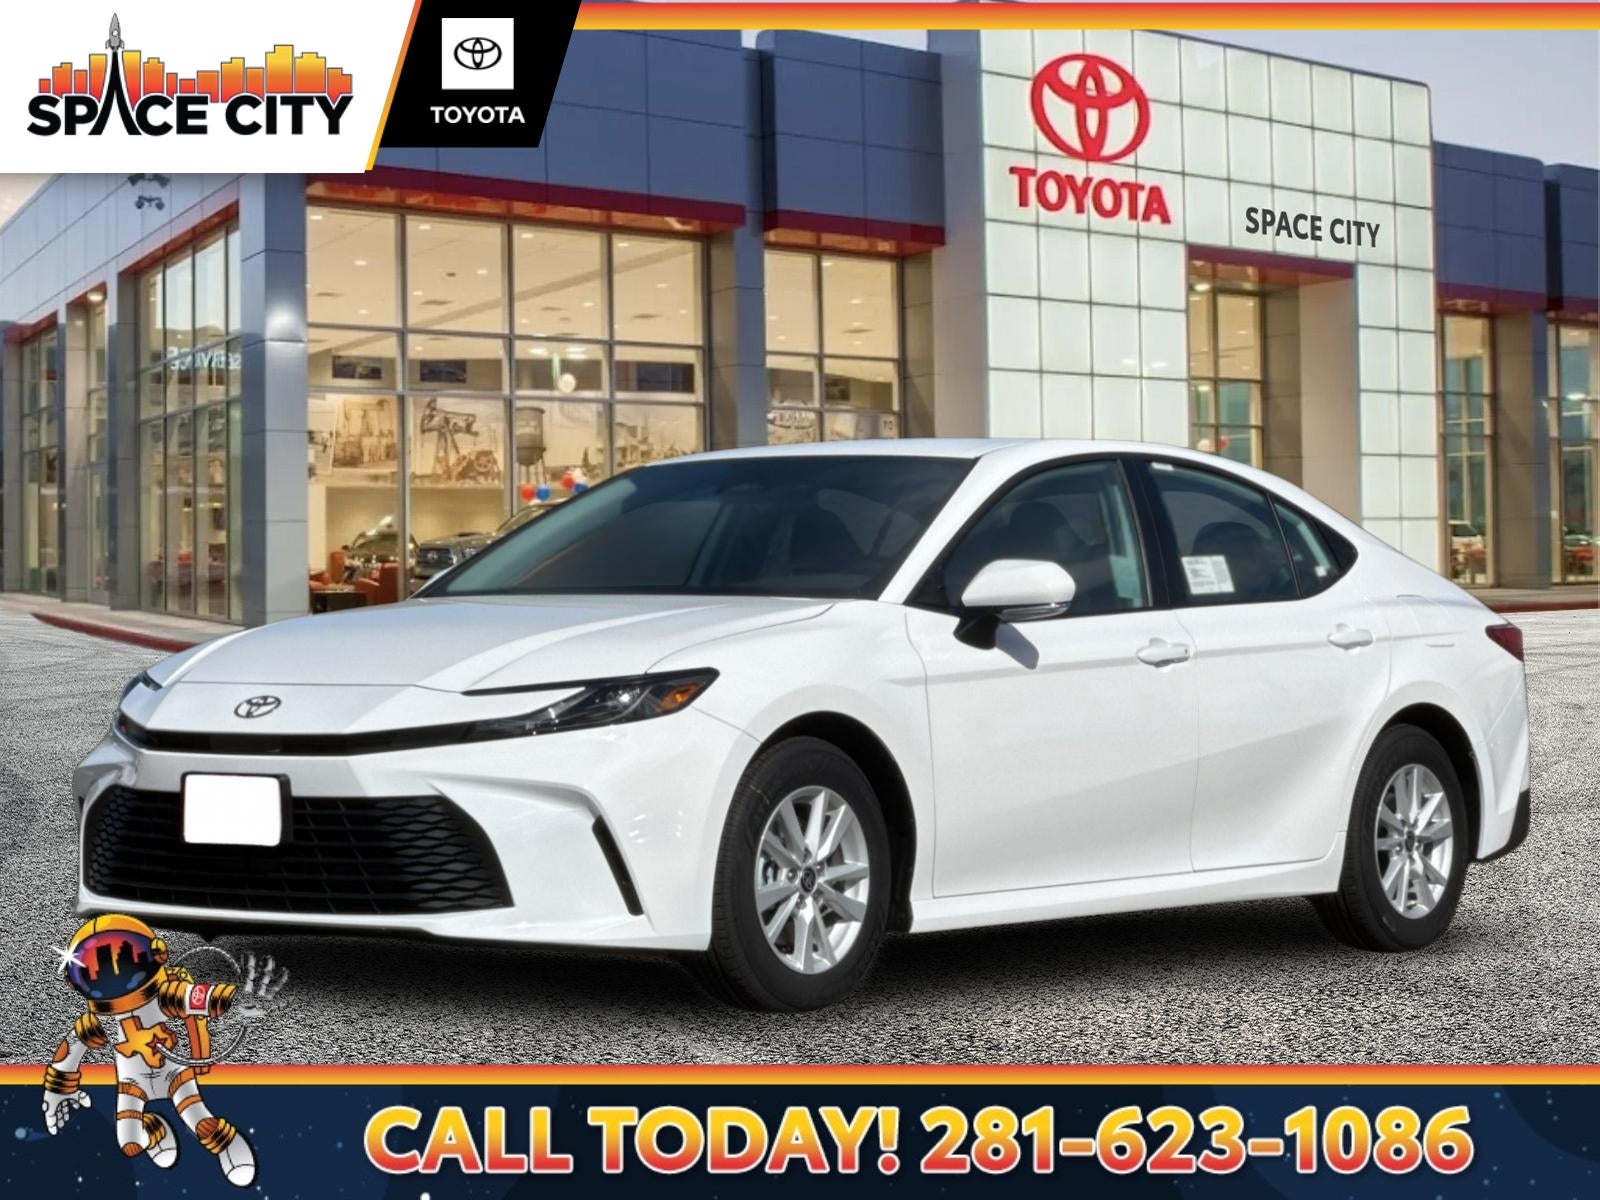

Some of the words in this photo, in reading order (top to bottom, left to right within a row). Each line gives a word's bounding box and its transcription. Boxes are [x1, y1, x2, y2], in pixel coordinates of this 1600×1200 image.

[1009, 165, 1171, 225] TOYOTA
[1245, 206, 1322, 242] SPACE
[1329, 217, 1381, 248] CITY
